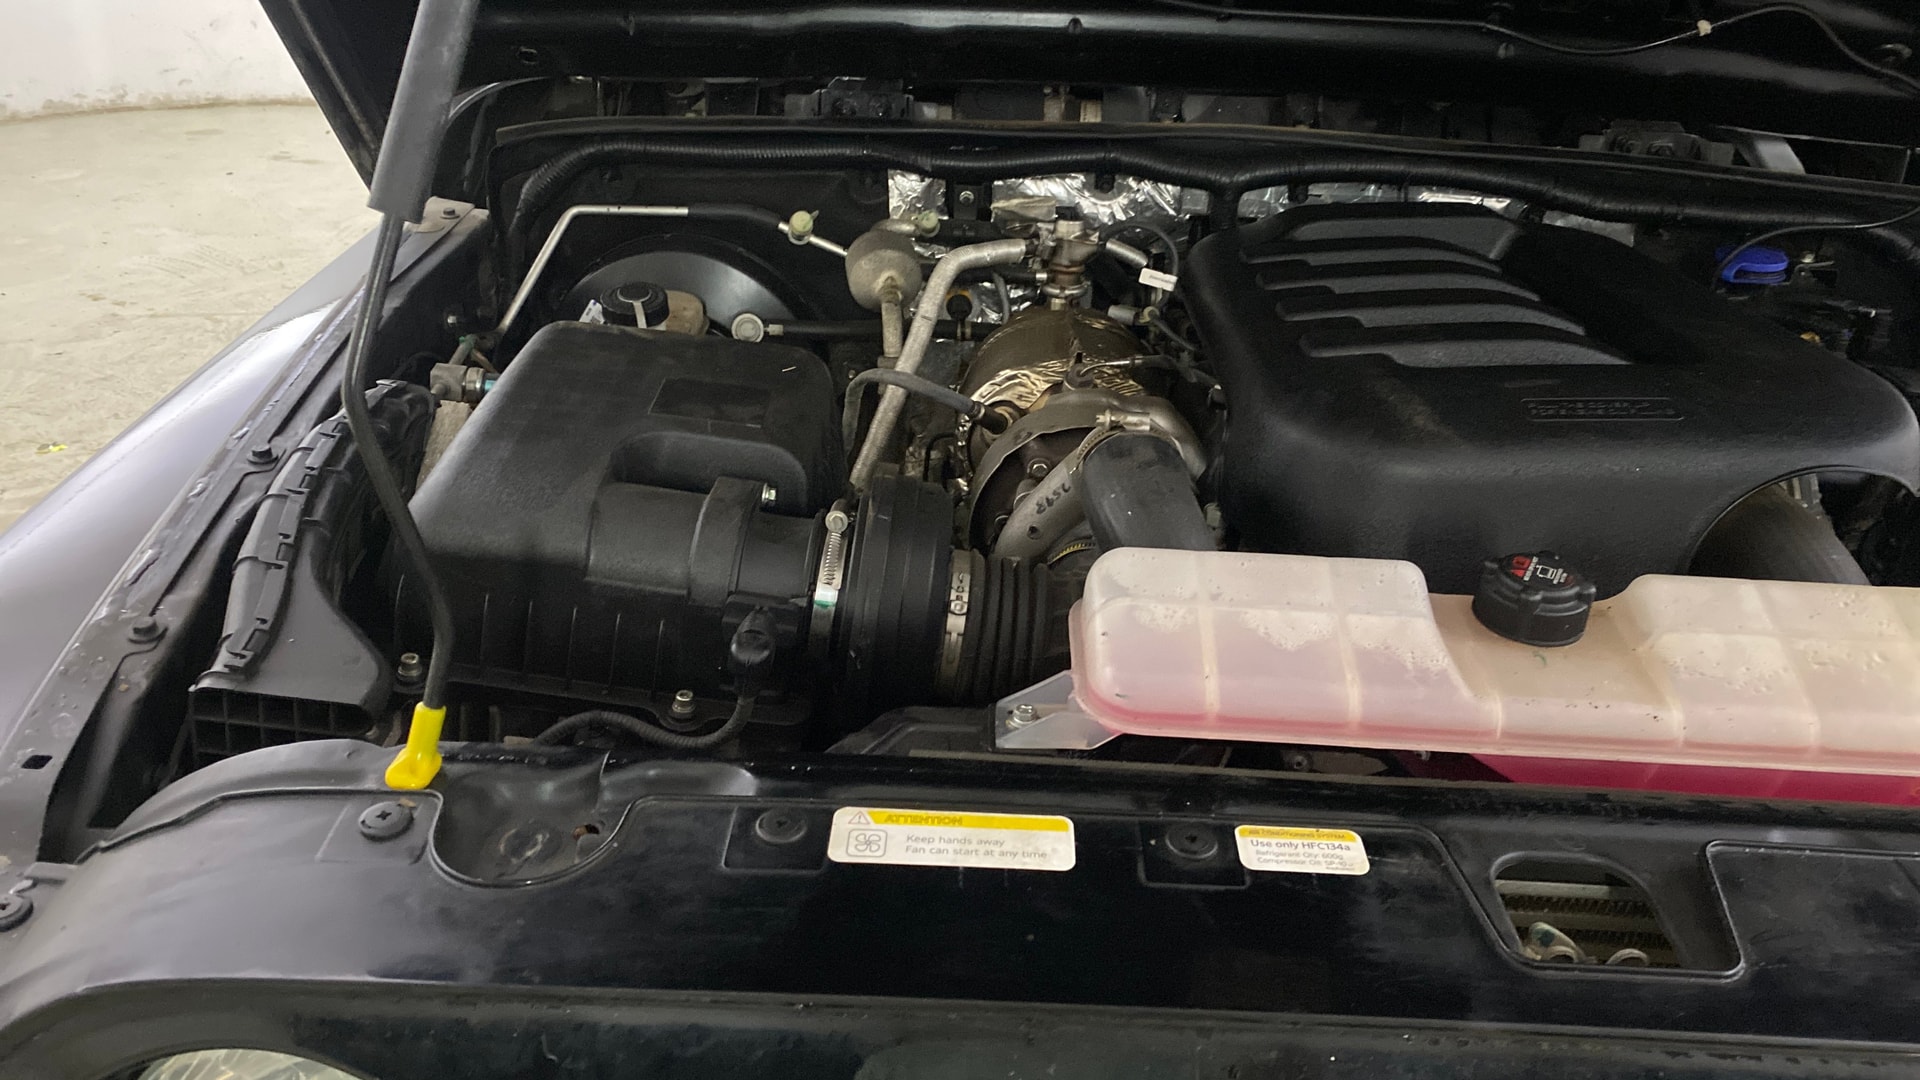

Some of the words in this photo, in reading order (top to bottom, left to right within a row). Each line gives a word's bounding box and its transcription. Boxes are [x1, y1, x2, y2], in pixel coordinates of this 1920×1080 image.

[884, 814, 963, 826] ATTENTION
[906, 835, 935, 846] Keep
[939, 835, 972, 846] hands
[976, 838, 1005, 848] away
[1251, 840, 1272, 848] Use
[1275, 840, 1299, 850] only
[1302, 841, 1351, 851] HFC134a
[905, 845, 925, 854] Fan
[953, 847, 979, 856] start
[983, 848, 995, 857] at
[998, 850, 1018, 859] any
[1021, 850, 1048, 859] time
[1256, 849, 1301, 858] Refrigerant
[1257, 857, 1307, 865] Compressor
